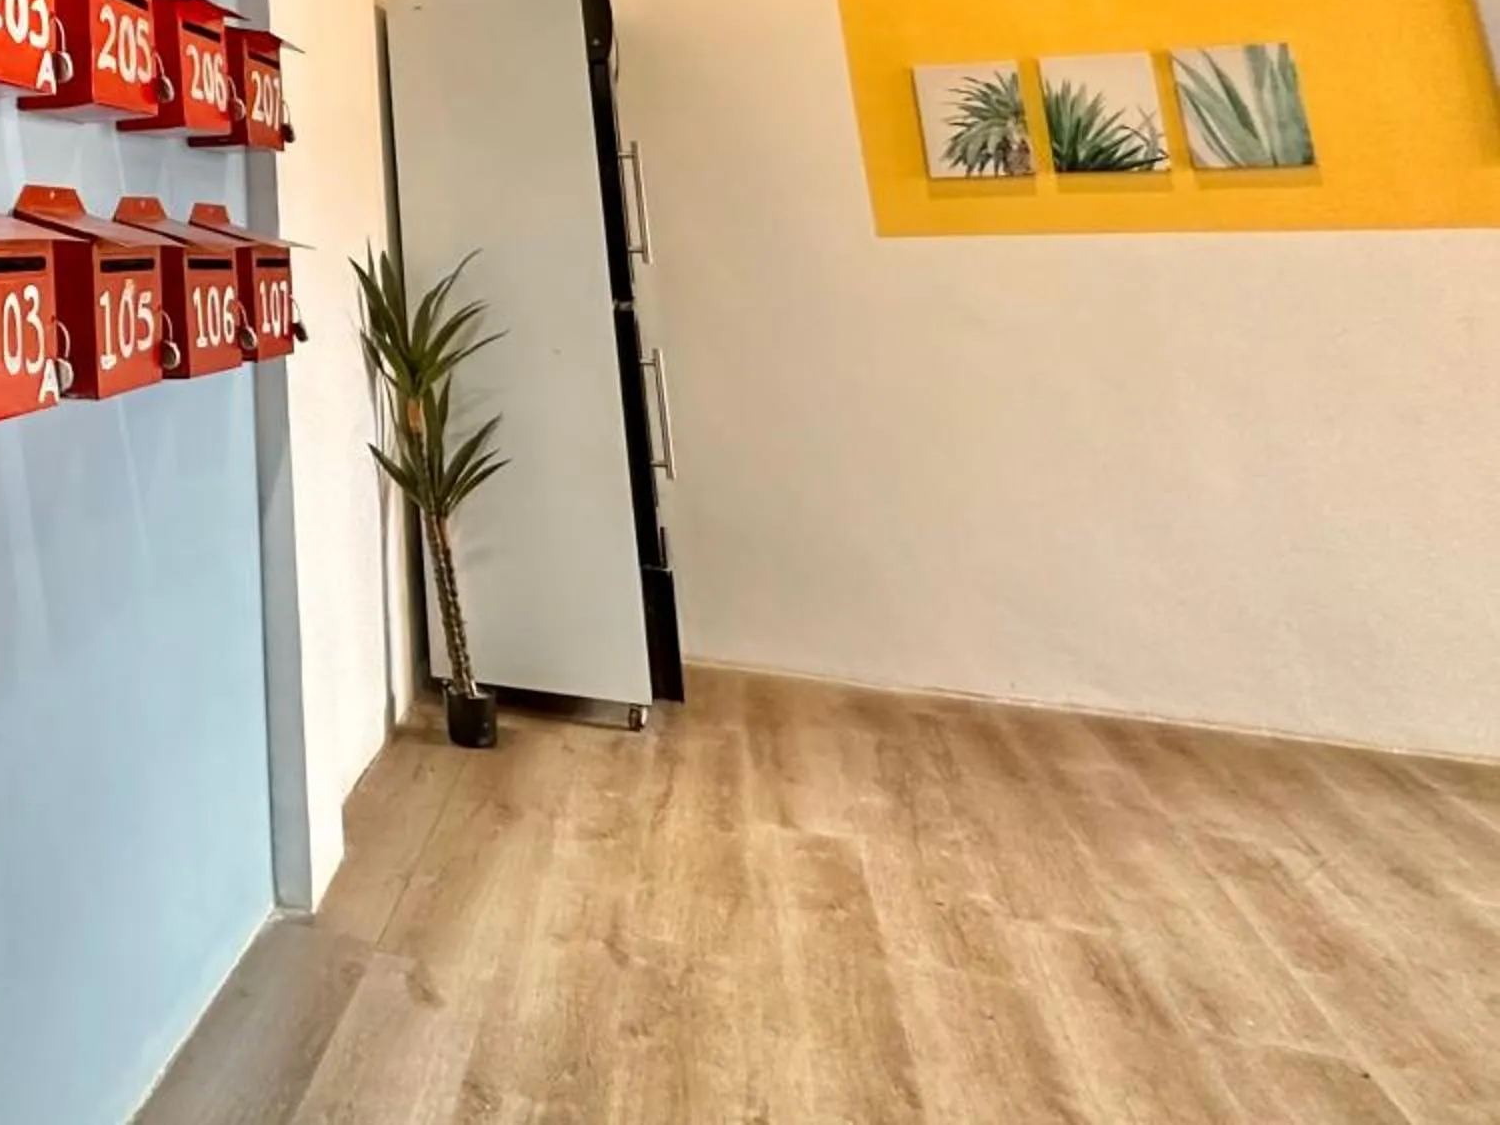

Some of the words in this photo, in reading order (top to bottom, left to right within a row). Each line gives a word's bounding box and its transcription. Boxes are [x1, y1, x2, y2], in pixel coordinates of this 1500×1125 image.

[36, 50, 57, 94] A
[97, 4, 153, 83] 205
[185, 44, 228, 112] 206
[250, 70, 282, 132] 207
[99, 279, 155, 371] 105
[193, 285, 235, 348] 106
[259, 279, 290, 338] 107
[38, 358, 61, 404] A
